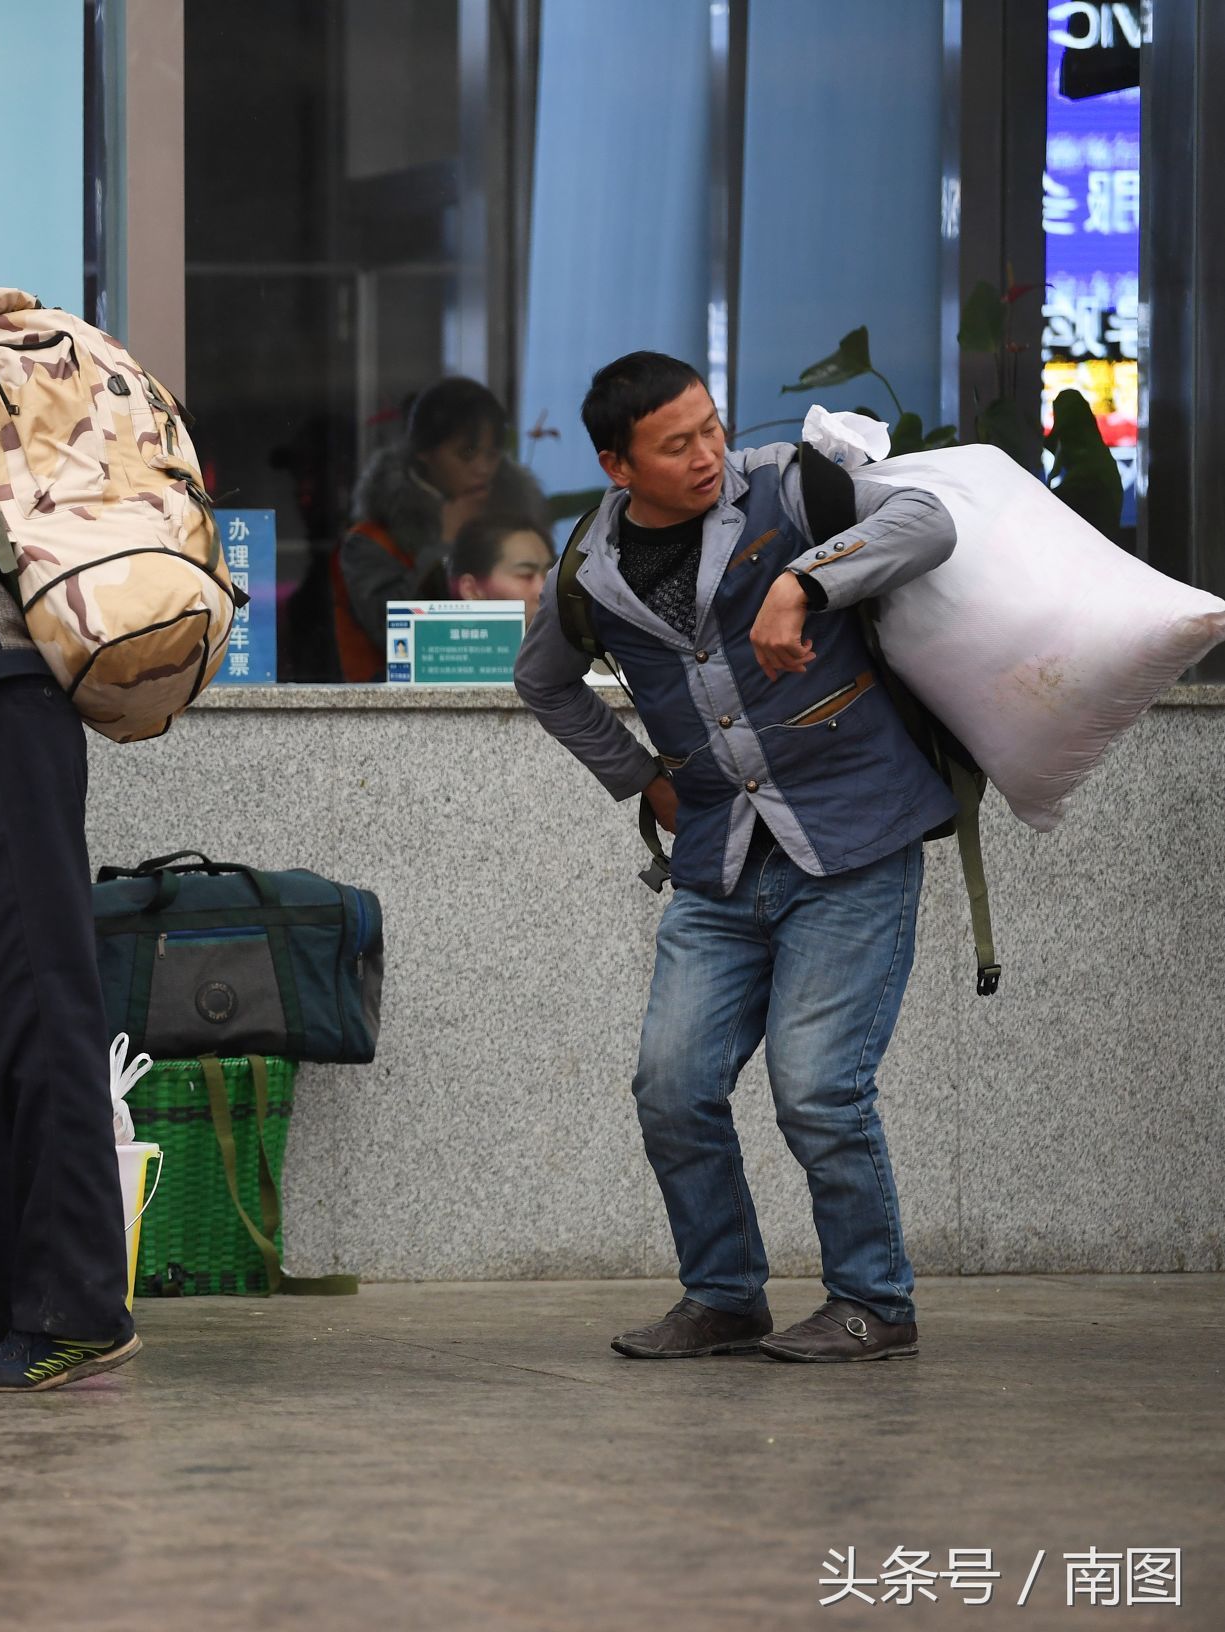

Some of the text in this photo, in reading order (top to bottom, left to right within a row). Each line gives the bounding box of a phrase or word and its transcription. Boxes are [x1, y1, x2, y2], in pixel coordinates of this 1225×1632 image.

[228, 517, 250, 677] 办理网购车票
